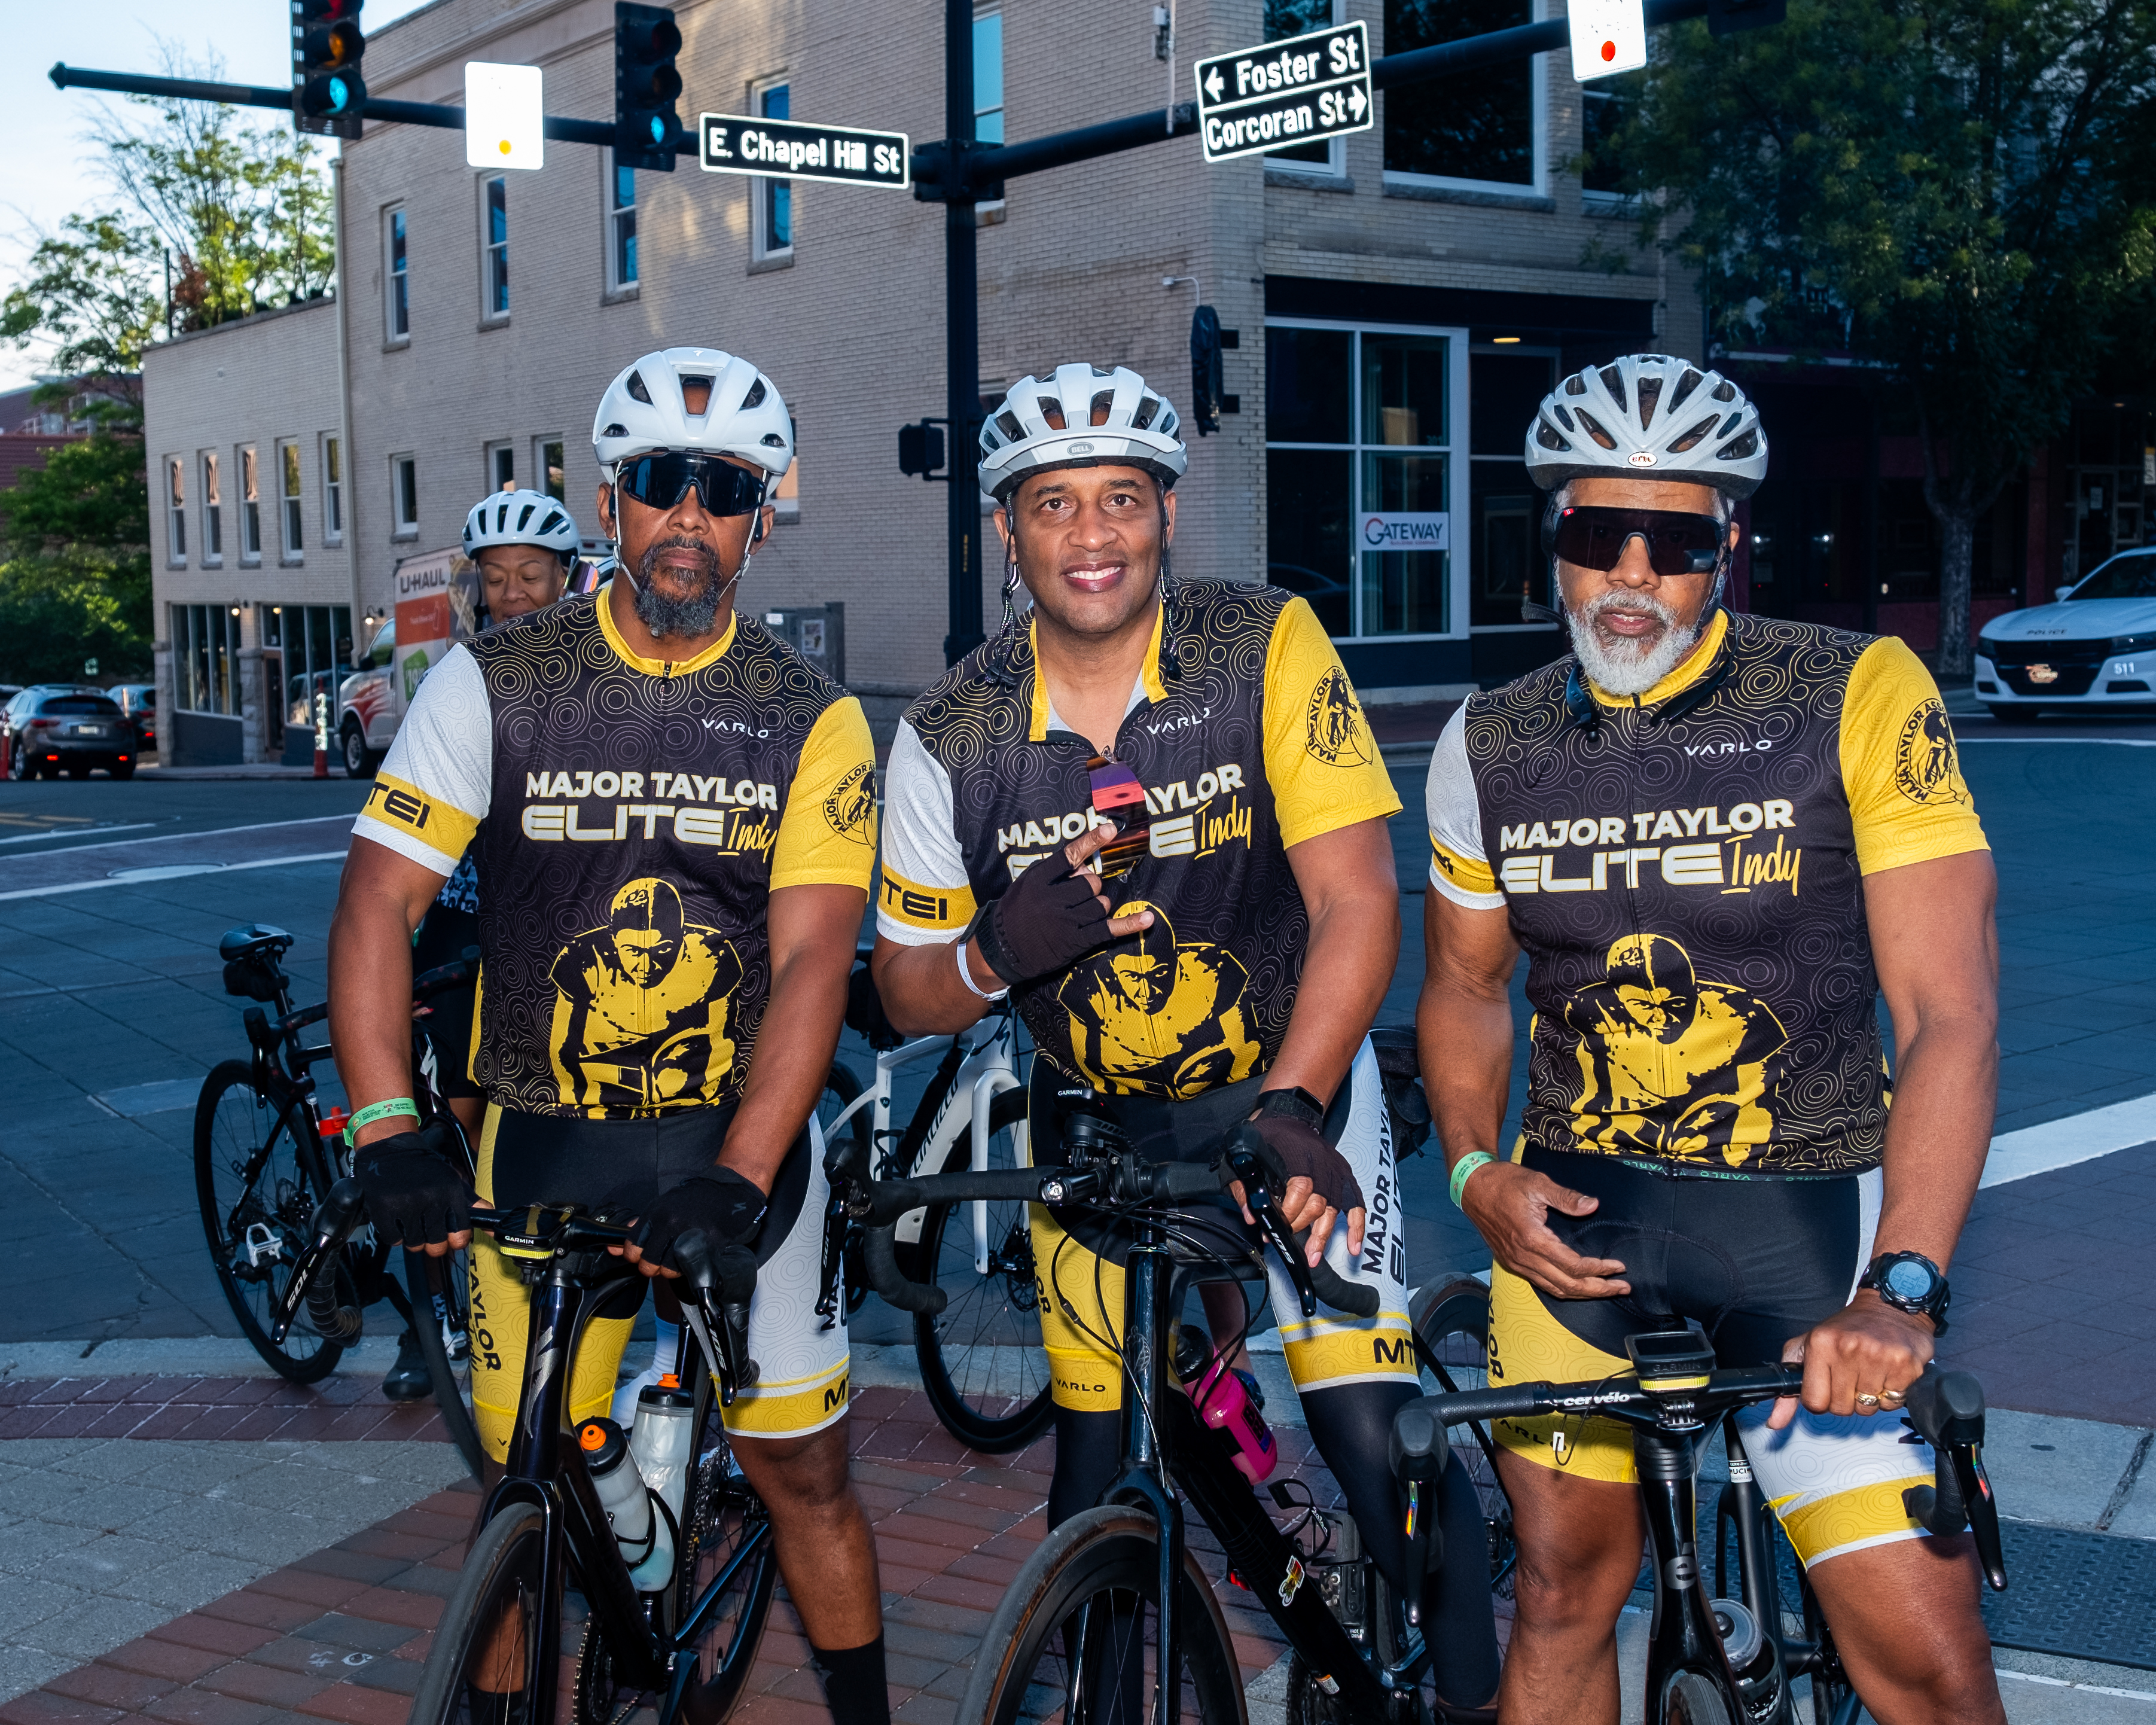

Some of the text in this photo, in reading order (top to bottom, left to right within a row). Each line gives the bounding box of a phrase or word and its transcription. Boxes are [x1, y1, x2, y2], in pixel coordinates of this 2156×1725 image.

[1236, 34, 1359, 95] Foster St
[1206, 90, 1347, 150] Corcoran St
[709, 127, 901, 174] E. Chapel Hill St
[1365, 517, 1443, 545] GATEWAY
[701, 718, 769, 739] VARLO
[1684, 739, 1773, 757] VARLO
[526, 771, 778, 811] MAJOR TAYLOR
[522, 804, 725, 846] ELITE
[1194, 795, 1252, 860] Indy
[1499, 799, 1796, 852] MAJOR TAYLOR
[1499, 842, 1724, 894] ELITE
[1721, 834, 1801, 896] Indy
[1700, 1169, 1751, 1181] VARLO
[504, 1235, 535, 1245] GARMIN
[1361, 1174, 1391, 1275] MAJOR
[1271, 1232, 1295, 1265] 105
[287, 1269, 308, 1312] 105
[468, 1252, 502, 1372] TAYLOR
[709, 1327, 727, 1371] 105
[1652, 1361, 1701, 1372] GARMIN
[1055, 1376, 1106, 1393] VARLO
[1563, 1391, 1631, 1407] cervélo
